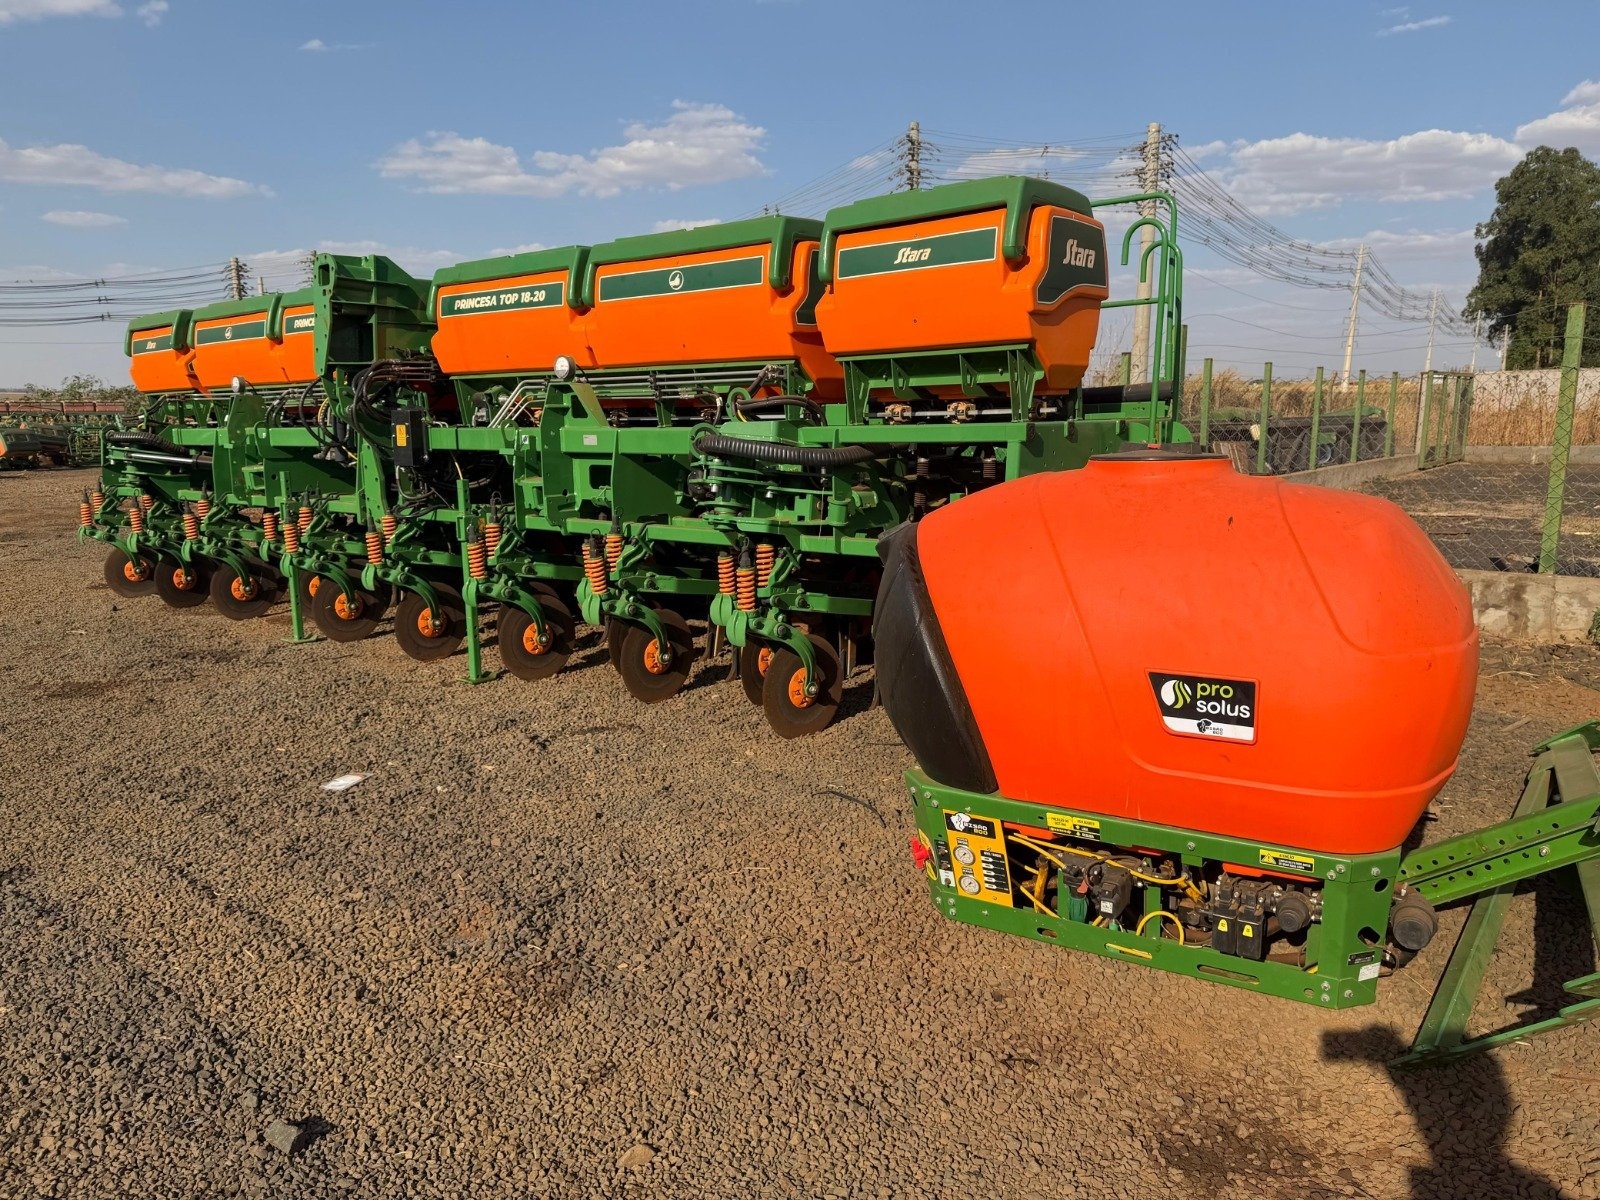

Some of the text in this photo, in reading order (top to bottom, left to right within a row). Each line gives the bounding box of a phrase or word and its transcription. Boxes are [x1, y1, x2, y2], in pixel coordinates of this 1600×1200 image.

[894, 247, 931, 265] Stara
[1063, 238, 1095, 268] Stara
[454, 290, 546, 310] PRINCESA TOP 18-20
[1197, 683, 1233, 699] pro
[1196, 700, 1251, 718] solus
